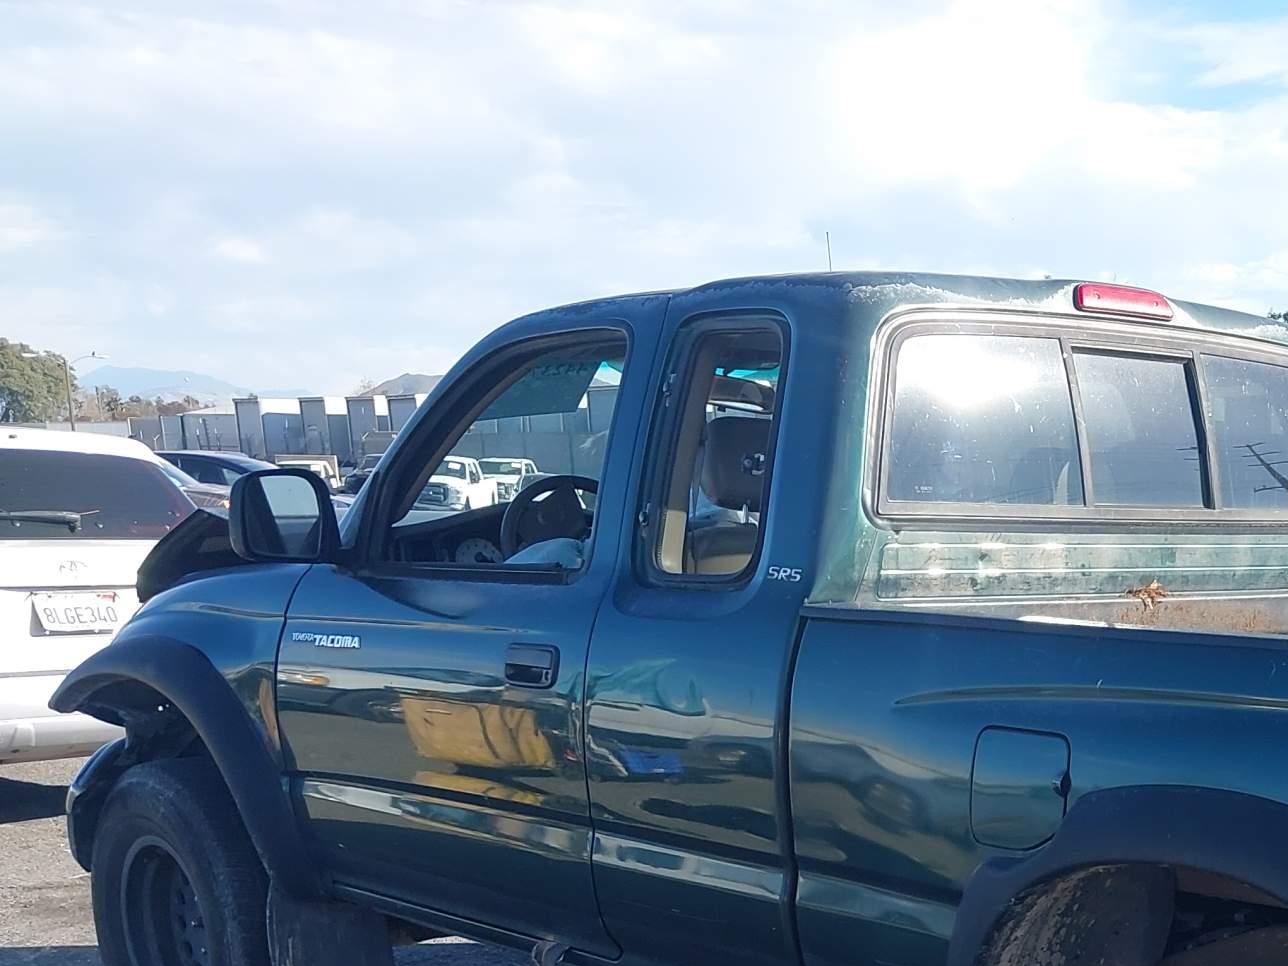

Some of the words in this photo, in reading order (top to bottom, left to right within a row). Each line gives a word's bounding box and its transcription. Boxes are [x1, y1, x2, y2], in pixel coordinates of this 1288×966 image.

[767, 566, 802, 582] SR5
[43, 606, 118, 624] 8LGE340
[314, 634, 361, 649] TACOMA
